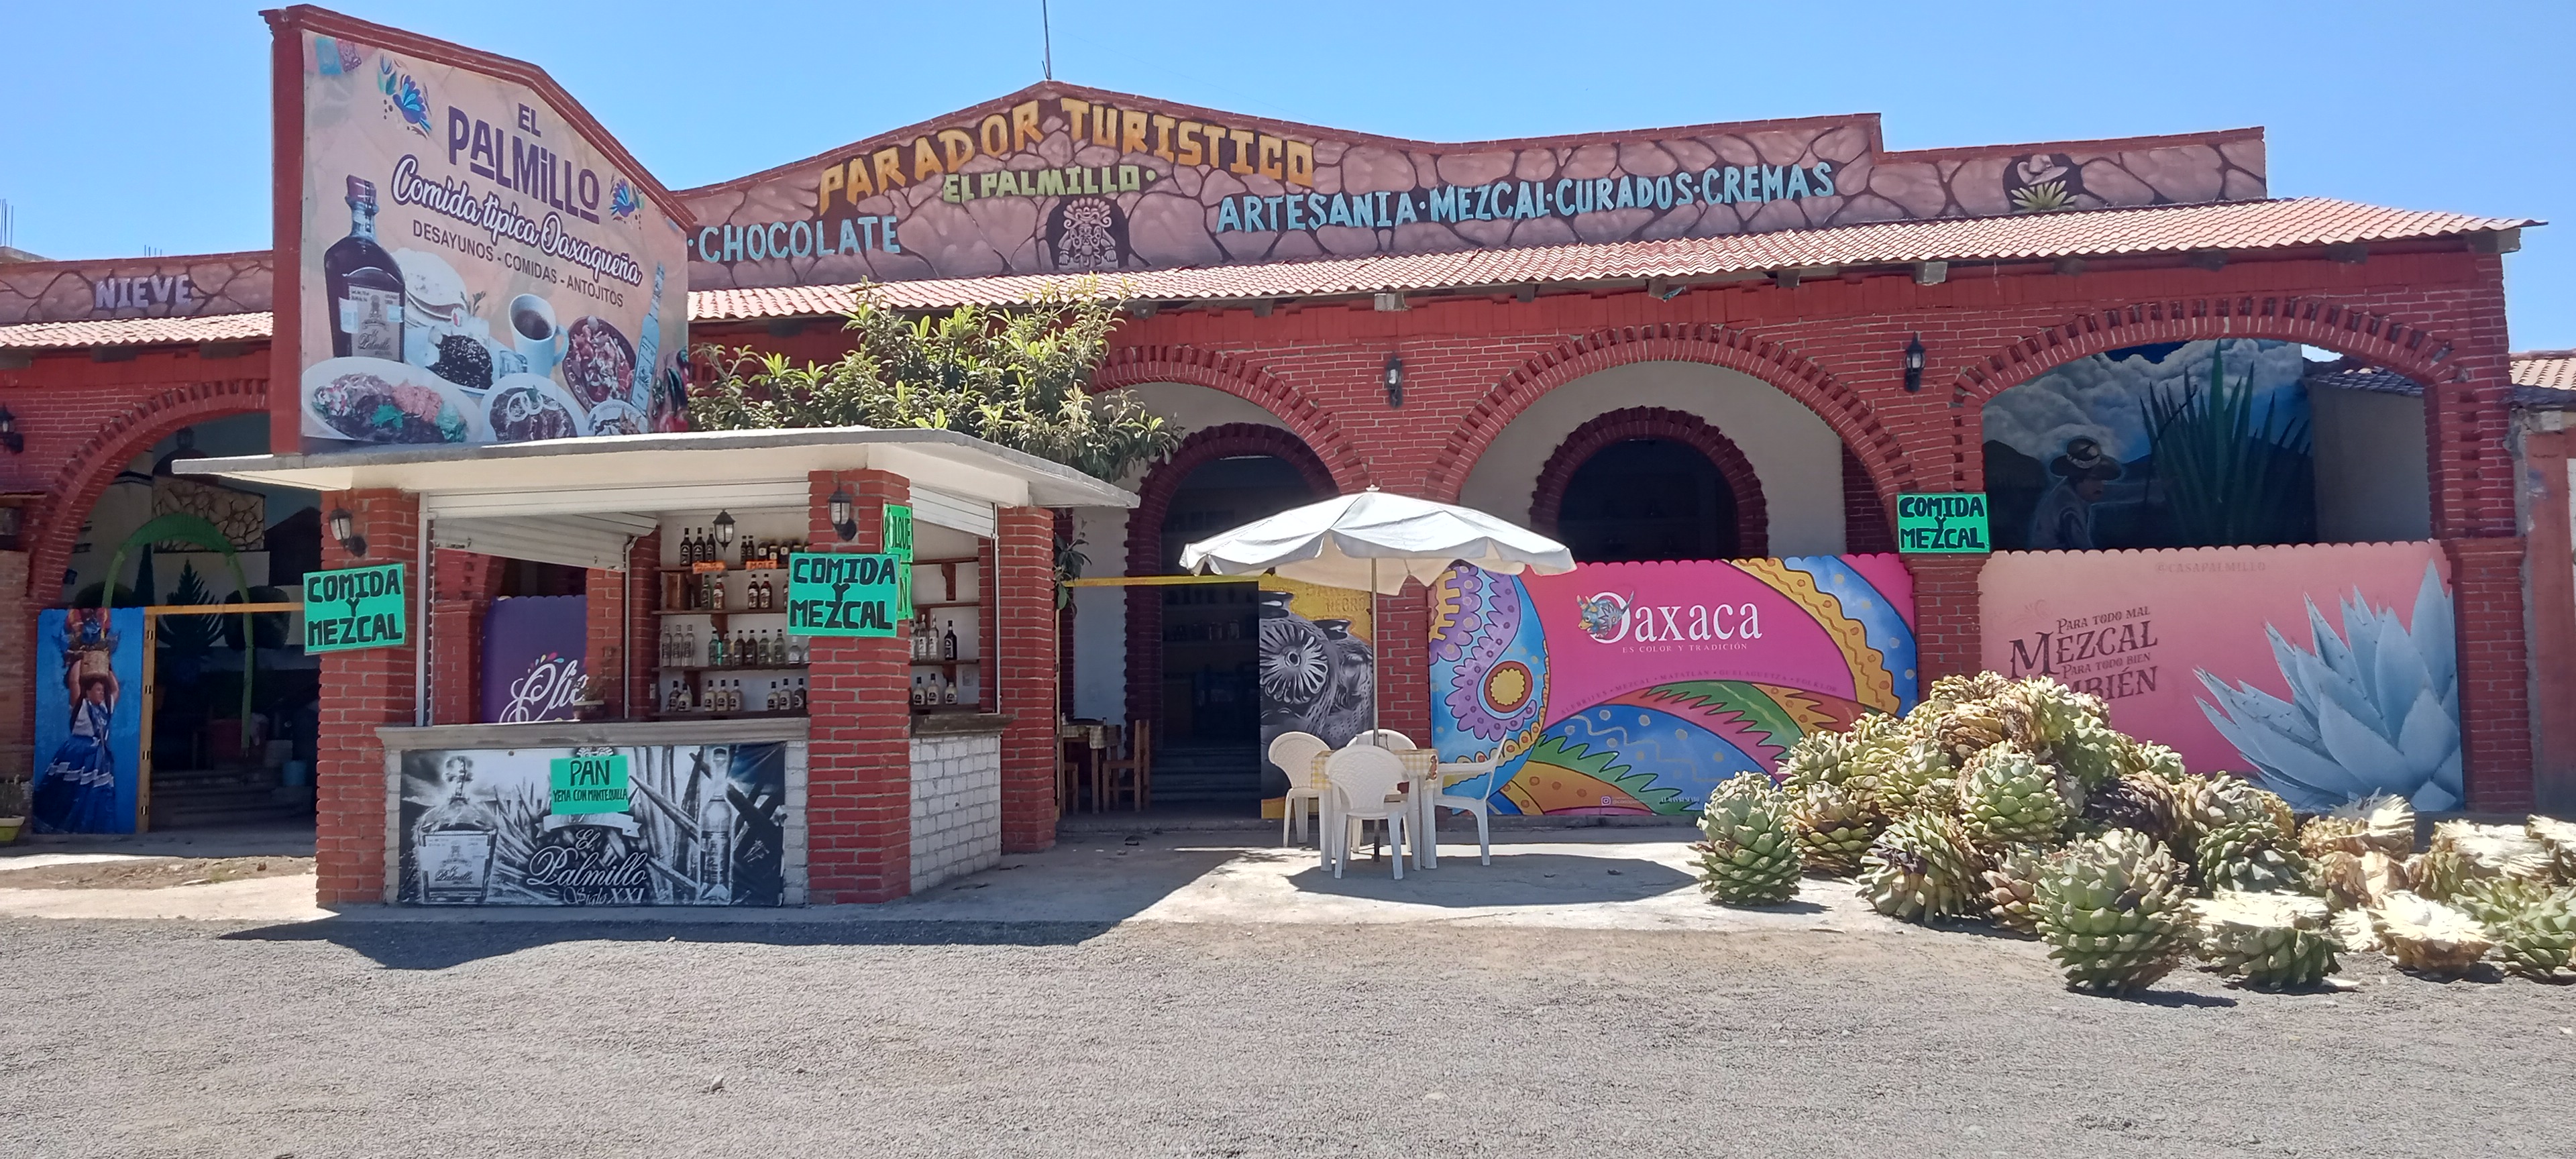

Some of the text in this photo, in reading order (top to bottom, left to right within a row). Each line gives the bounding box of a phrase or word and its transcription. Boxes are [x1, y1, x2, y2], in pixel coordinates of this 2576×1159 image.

[518, 103, 541, 137] EL
[819, 97, 1313, 216] PARADOR TURISTICO
[943, 164, 1140, 203] EL PALMILLO
[1216, 161, 1835, 233] ARTESANIA MEZCAL CURADOS CREMAS
[392, 154, 482, 226] Comida
[539, 211, 643, 287] Oaxaqueña
[698, 215, 901, 263] CHOCOLATE
[413, 220, 624, 307] DESAYUNOS COMIDAS ANTOJITOS
[95, 274, 193, 309] NIEVE
[1899, 496, 1985, 518] COMIDA
[1934, 514, 1947, 530] Y
[1900, 527, 1986, 549] MEZCAL
[308, 569, 401, 602] COMIDA
[793, 557, 896, 585] COMIDA
[345, 597, 360, 617] Y
[832, 582, 851, 602] Y
[308, 613, 402, 646] MEZCAL
[790, 600, 894, 630] MEZCAL
[1589, 592, 1762, 644] Oaxaca
[2056, 606, 2151, 634] PARA TODO MAL
[1622, 646, 1635, 654] ES
[1640, 645, 1672, 653] COLOR
[1689, 642, 1748, 652] TRADICIÓN
[2008, 620, 2158, 680] MEZCAL
[2062, 652, 2151, 679] PARA TODO BIEN
[570, 760, 610, 786] PAN
[553, 787, 628, 803] YEMA CON MANTEQUILLA
[576, 829, 600, 850] El
[527, 845, 648, 886] Palmillo
[606, 887, 645, 903] XXI
